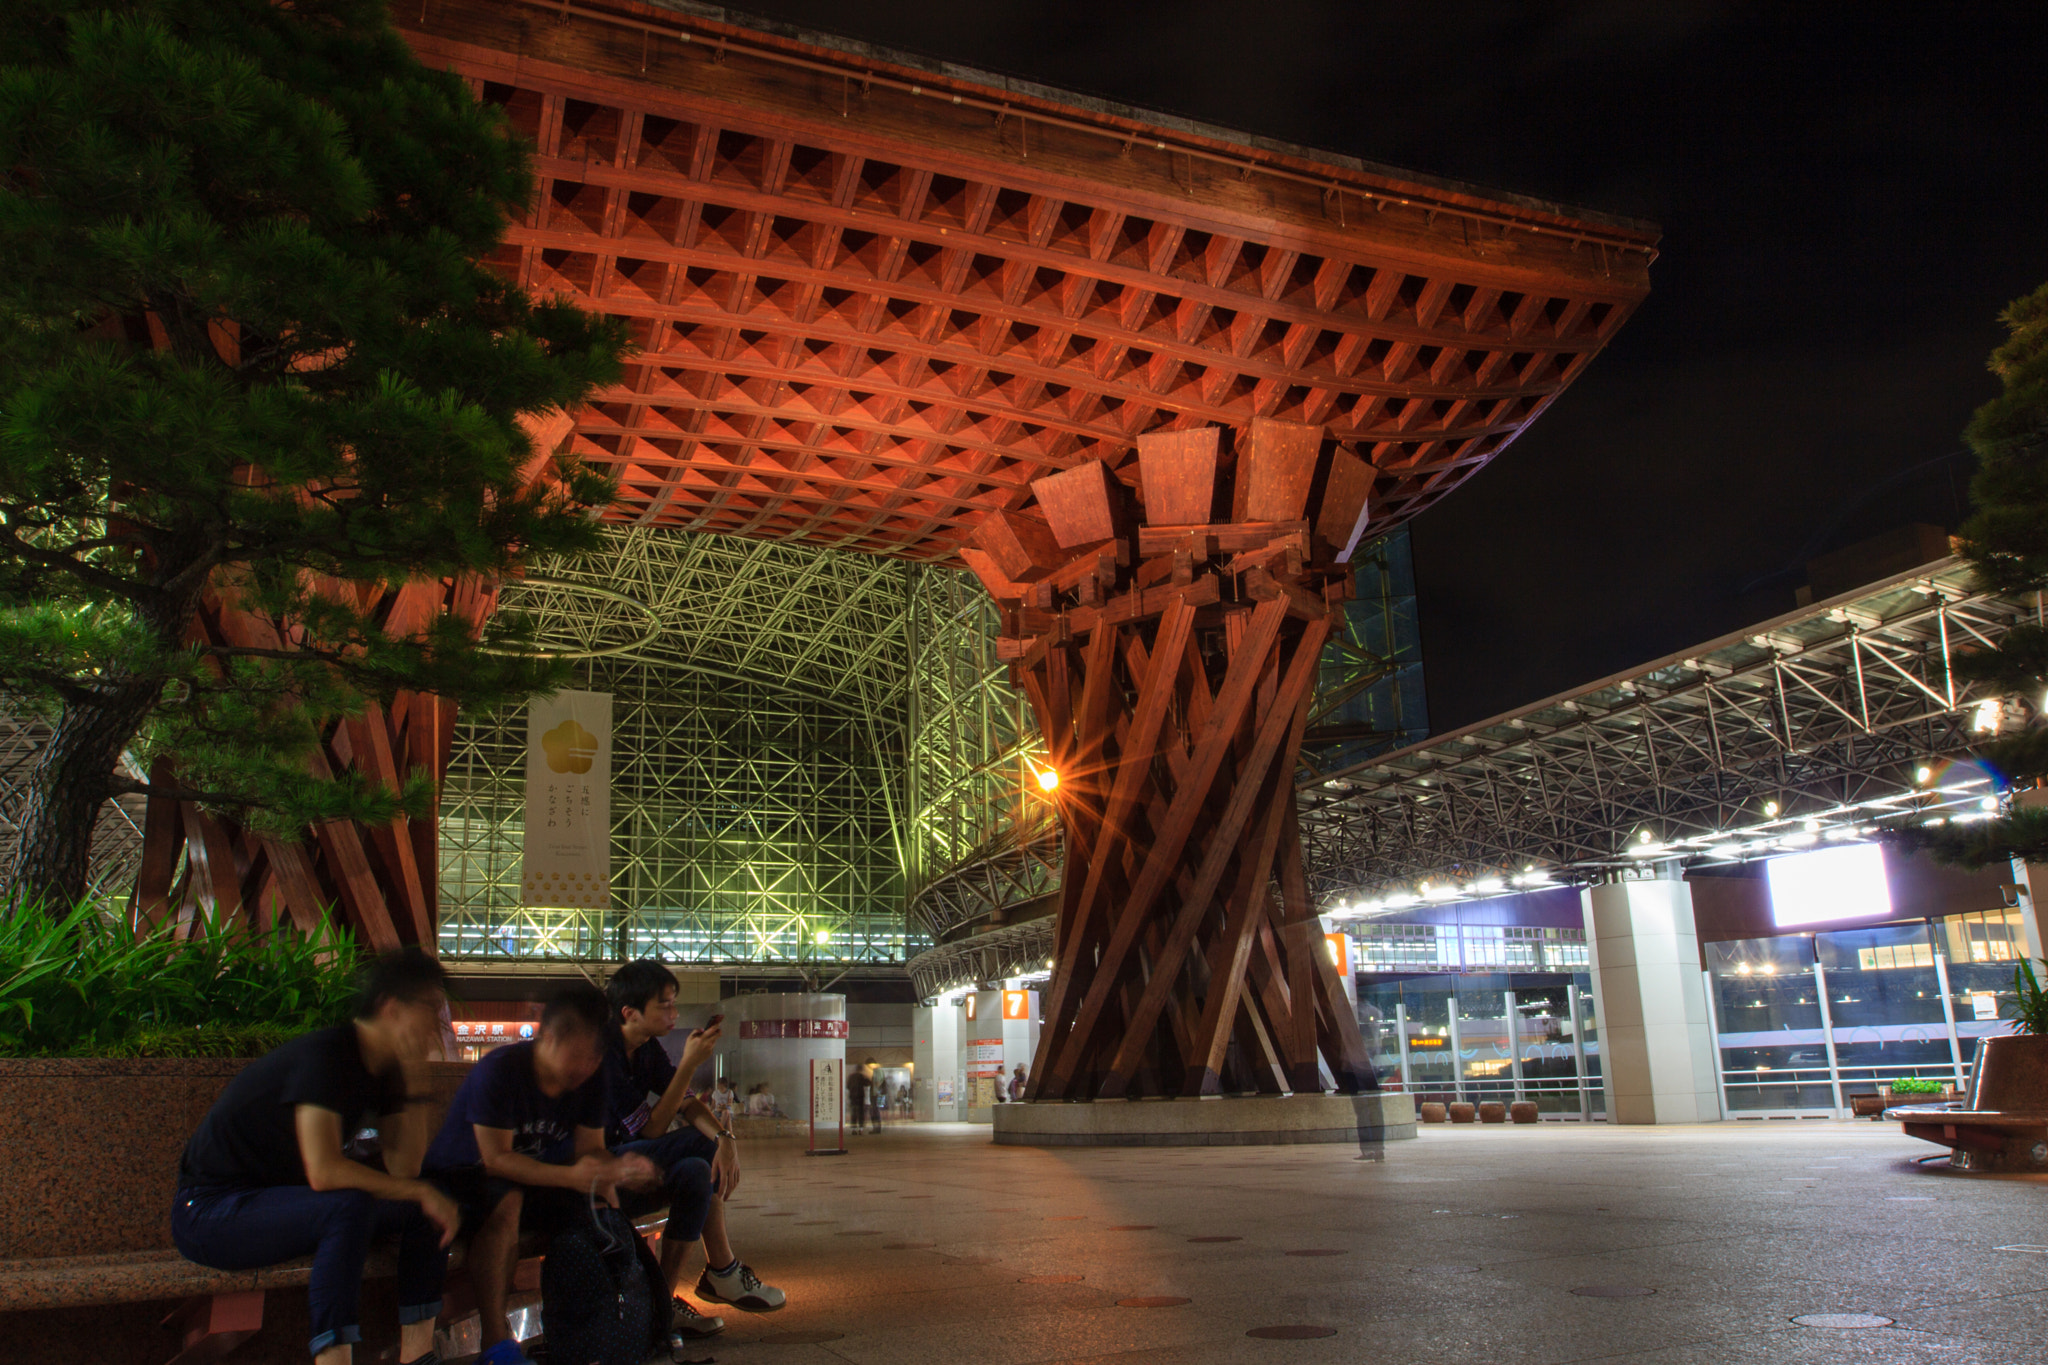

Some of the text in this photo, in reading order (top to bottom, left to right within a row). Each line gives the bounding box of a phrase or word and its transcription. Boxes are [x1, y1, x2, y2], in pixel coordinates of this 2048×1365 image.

[1007, 993, 1023, 1017] 7
[457, 1024, 504, 1036] 金沢駅
